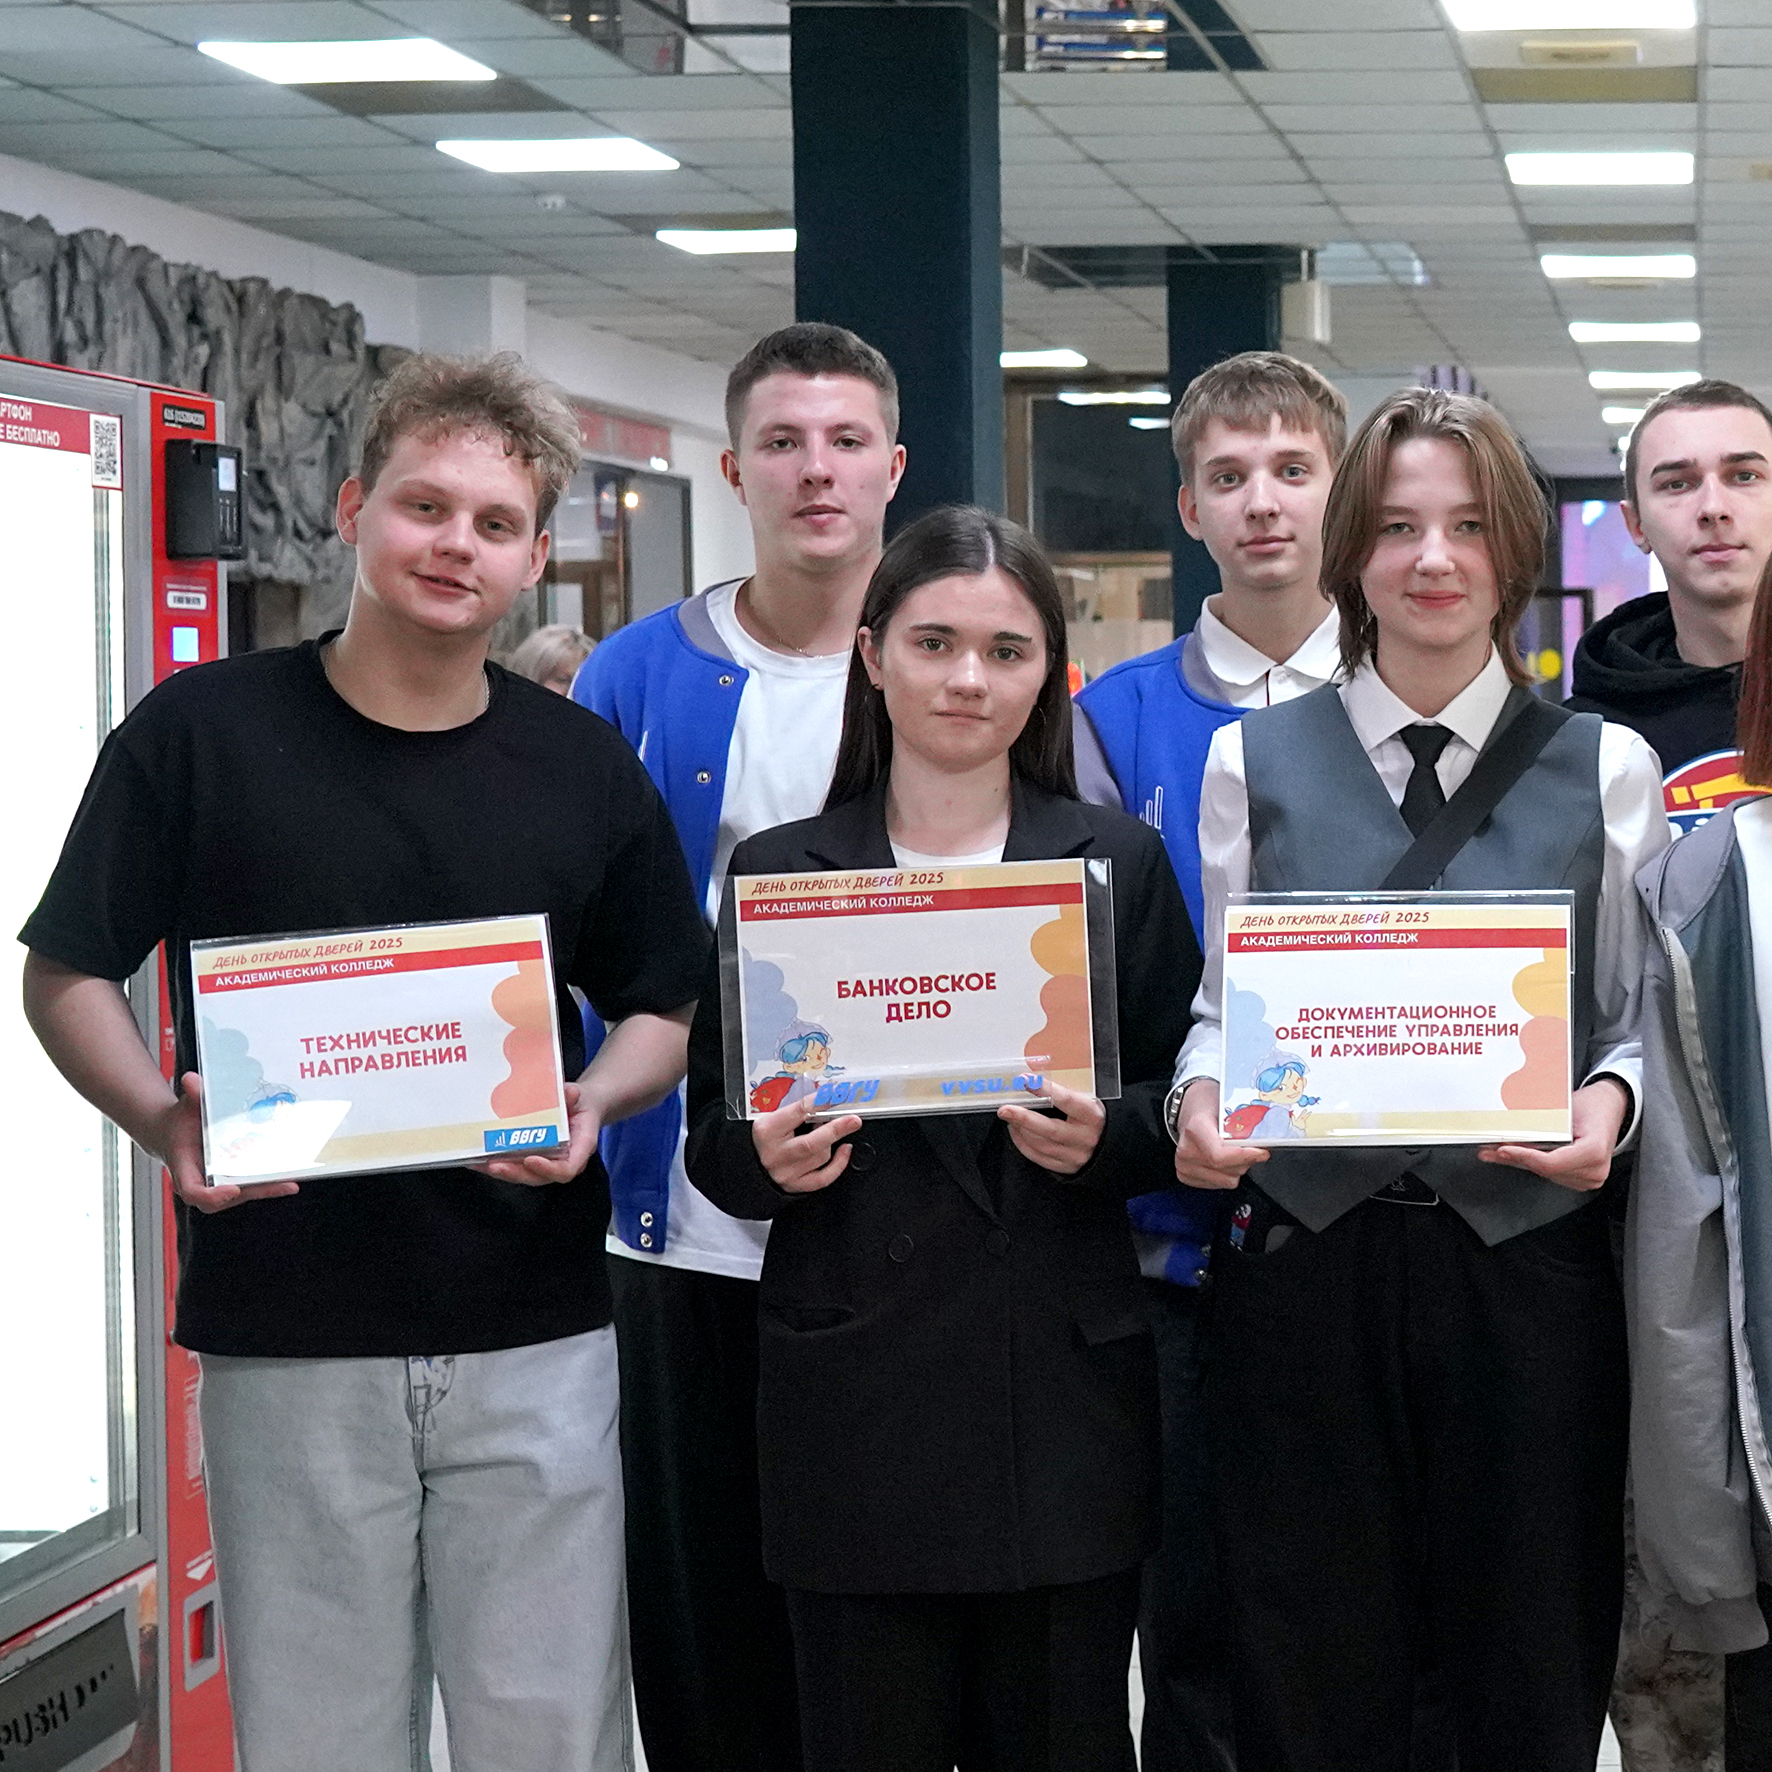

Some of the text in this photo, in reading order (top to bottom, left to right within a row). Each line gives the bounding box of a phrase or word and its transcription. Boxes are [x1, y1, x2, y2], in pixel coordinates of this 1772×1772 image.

[6, 423, 61, 447] БЕСПЛАТНО
[751, 871, 944, 896] ДЕНЬ ОТКРЫТЫХ ДВЕРЕЙ 2025
[753, 894, 935, 915] АКАДЕМИЧЕСКИЙ КОЛЛЕДЖ
[1240, 911, 1430, 929] ДЕНЬ ОТКРЫТЫХ ДВЕРЕЙ 2025
[1240, 932, 1419, 948] АКАДЕМИЧЕСКИЙ КОЛЛЕДЖ
[212, 937, 404, 970] ДЕНЬ ОТКРЫТЫХ ДВЕРЕЙ 2025
[214, 957, 395, 987] АКАДЕМИЧЕСКИЙ КОЛЛЕДЖ
[836, 971, 997, 999] БАНКОВСКОЕ
[885, 1000, 952, 1024] ДЕЛО
[1297, 1004, 1497, 1023] ДОКУМЕНТАЦИОННОЕ
[300, 1021, 463, 1055] ТЕХНИЧЕСКИЕ
[1274, 1022, 1520, 1041] ОБЕСПЕЧЕНИЕ УПРАВЛЕНИЯ
[1311, 1042, 1483, 1058] И АРХИВИРОВАНИЕ
[299, 1045, 468, 1080] НАПРАВЛЕНИЯ
[813, 1078, 881, 1107] ВВГУ
[509, 1127, 548, 1146] ВВГУ
